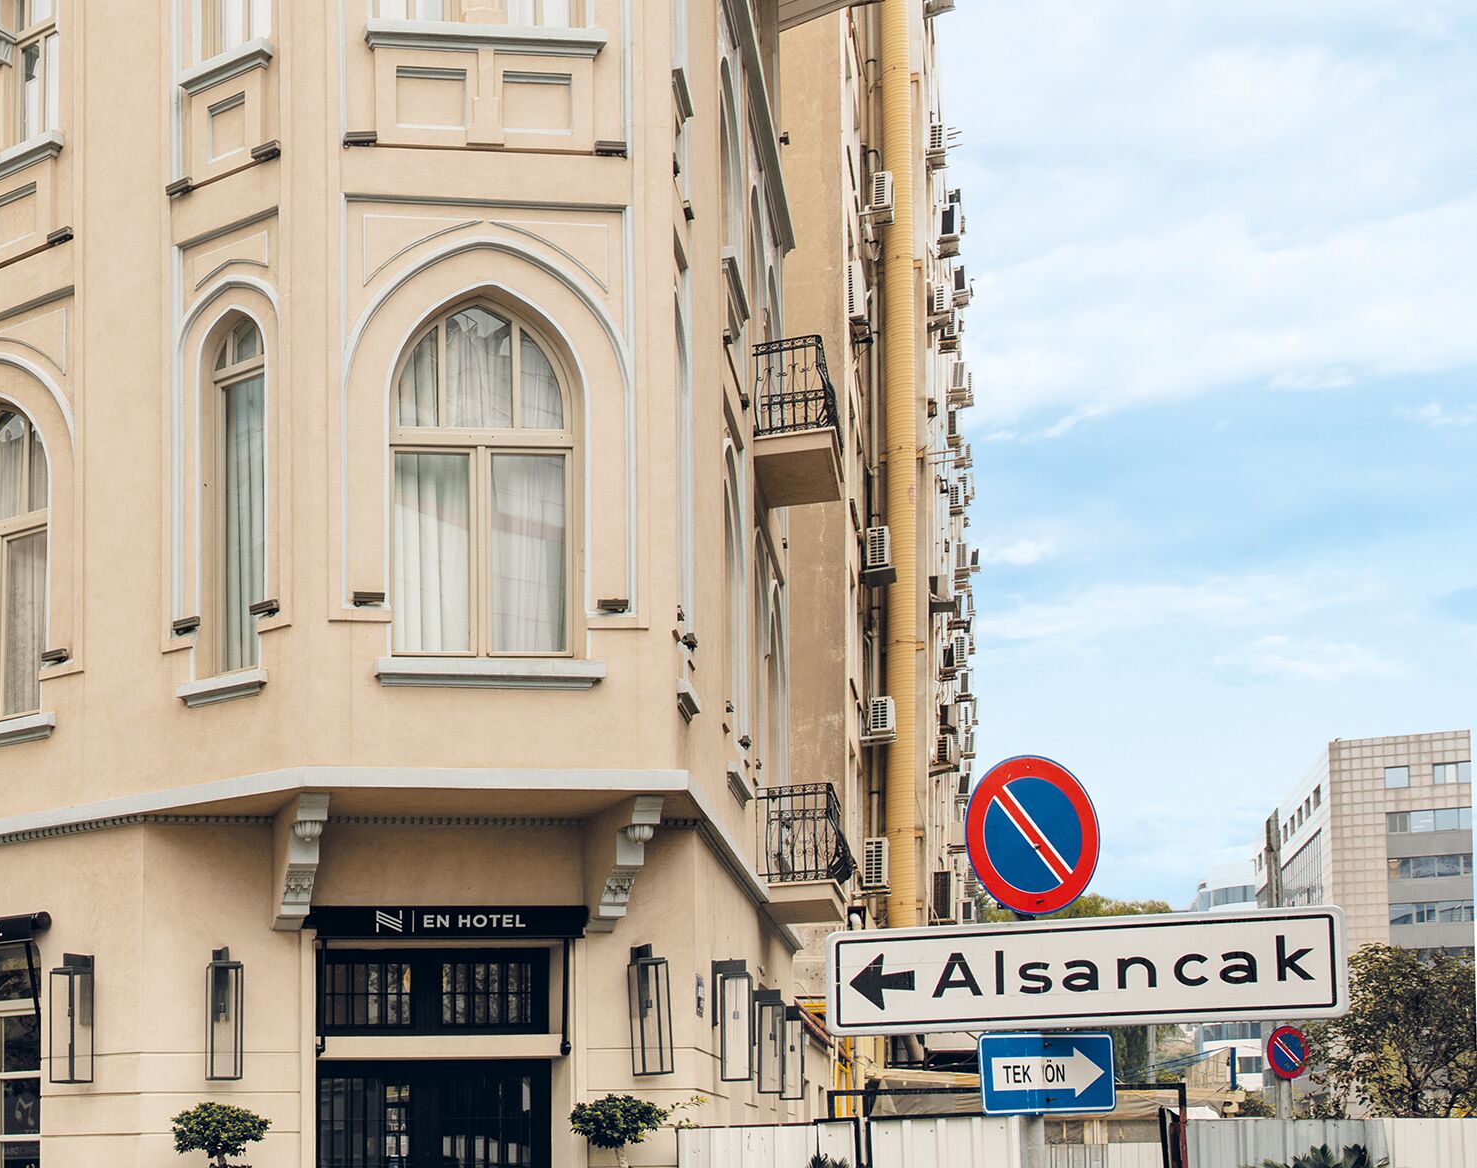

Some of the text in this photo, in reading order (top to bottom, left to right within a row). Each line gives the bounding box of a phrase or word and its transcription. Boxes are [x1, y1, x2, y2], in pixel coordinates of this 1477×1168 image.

[423, 914, 450, 928] EN
[458, 914, 526, 928] HOTEL
[932, 934, 1316, 998] Alsancak
[1003, 1065, 1032, 1083] TEK
